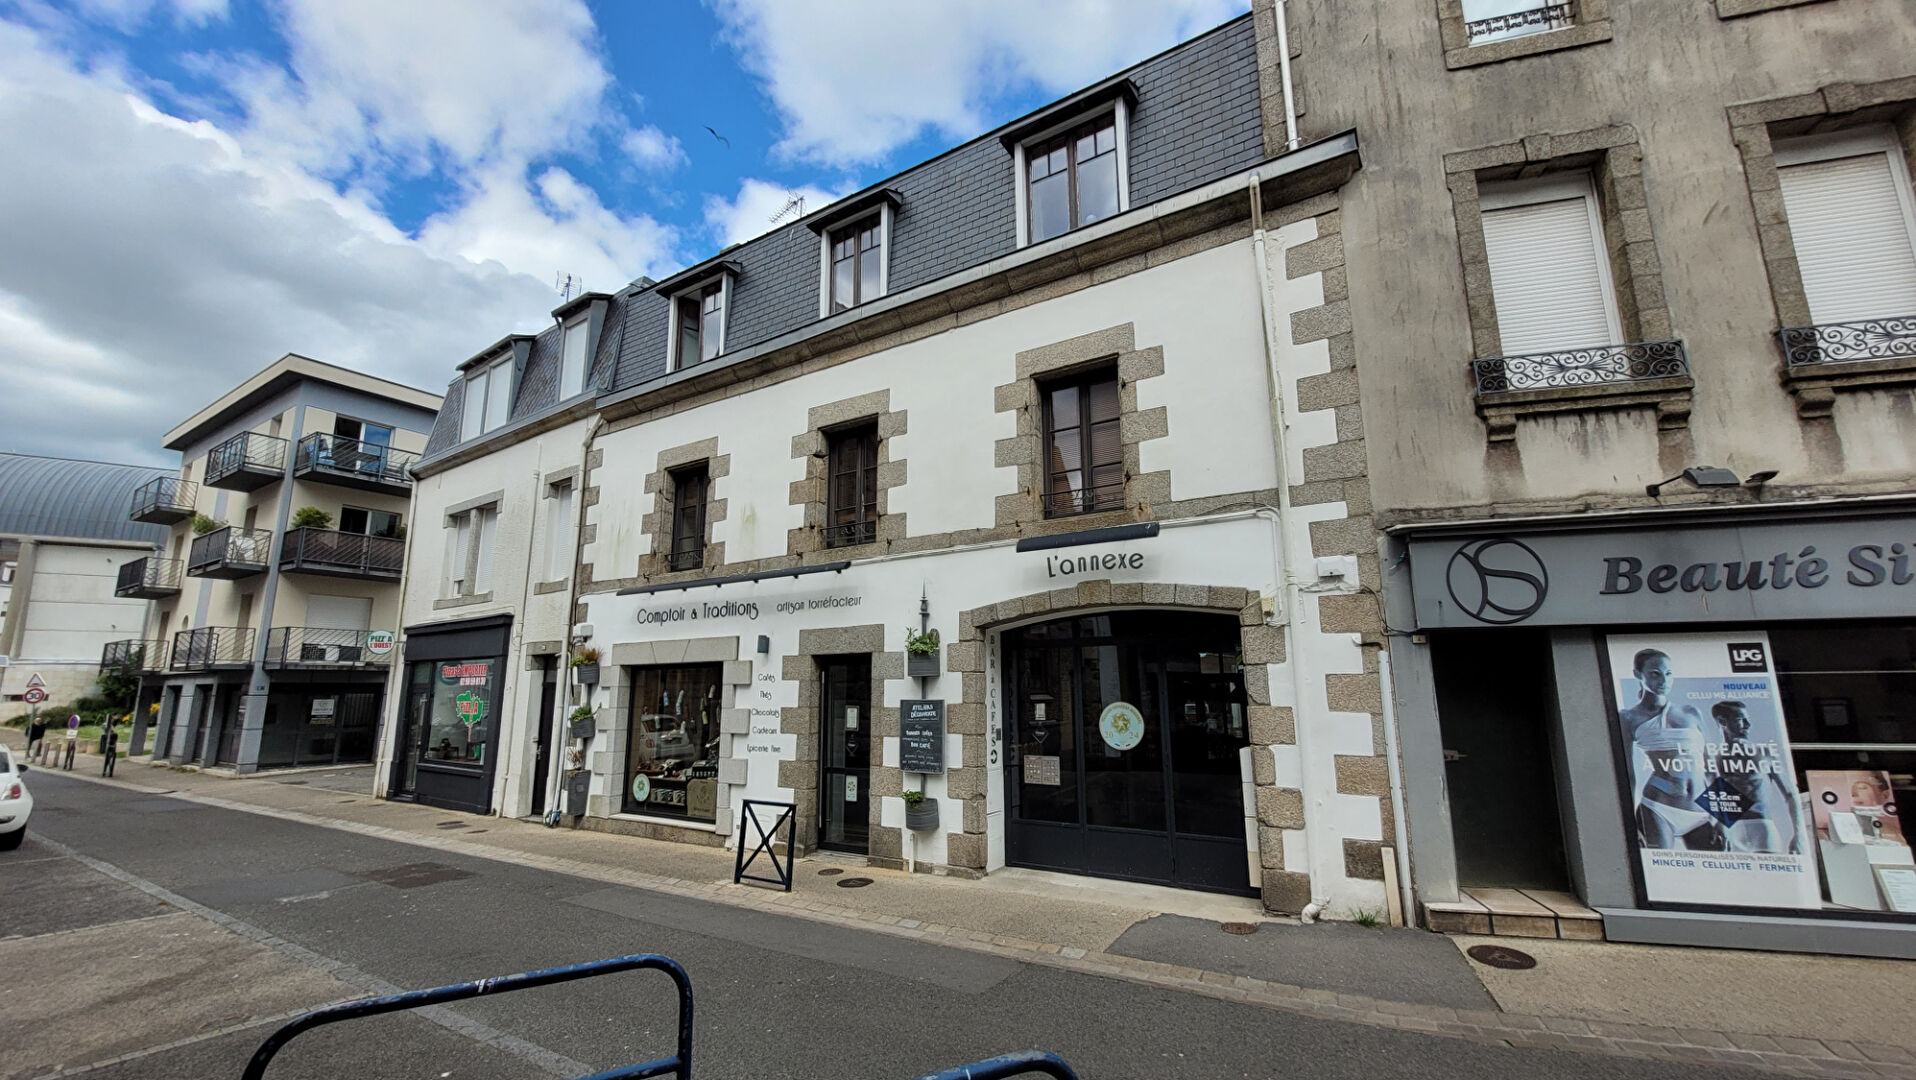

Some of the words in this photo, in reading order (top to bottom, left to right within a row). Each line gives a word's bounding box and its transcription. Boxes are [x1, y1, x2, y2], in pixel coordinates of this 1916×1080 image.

[1047, 553, 1144, 578] L'annexe
[1600, 545, 1829, 595] Beauté
[1847, 542, 1916, 587] Si
[777, 601, 804, 614] artisan
[808, 595, 862, 609] torréfacteur
[637, 608, 685, 626] Comptoir
[690, 608, 698, 619] &
[703, 601, 758, 620] Traditions
[1732, 649, 1763, 662] LPG
[758, 673, 776, 683] Cafés
[29, 692, 41, 700] 30
[1686, 691, 1712, 699] CELLU
[1726, 691, 1770, 699] ALLIANCE
[1706, 740, 1780, 757] BEAUTÉ
[1722, 759, 1783, 774] IMAGE
[1652, 859, 1695, 867] MINCEUR
[1702, 861, 1752, 871] CELLULITE
[1757, 855, 1797, 863] NATURELS
